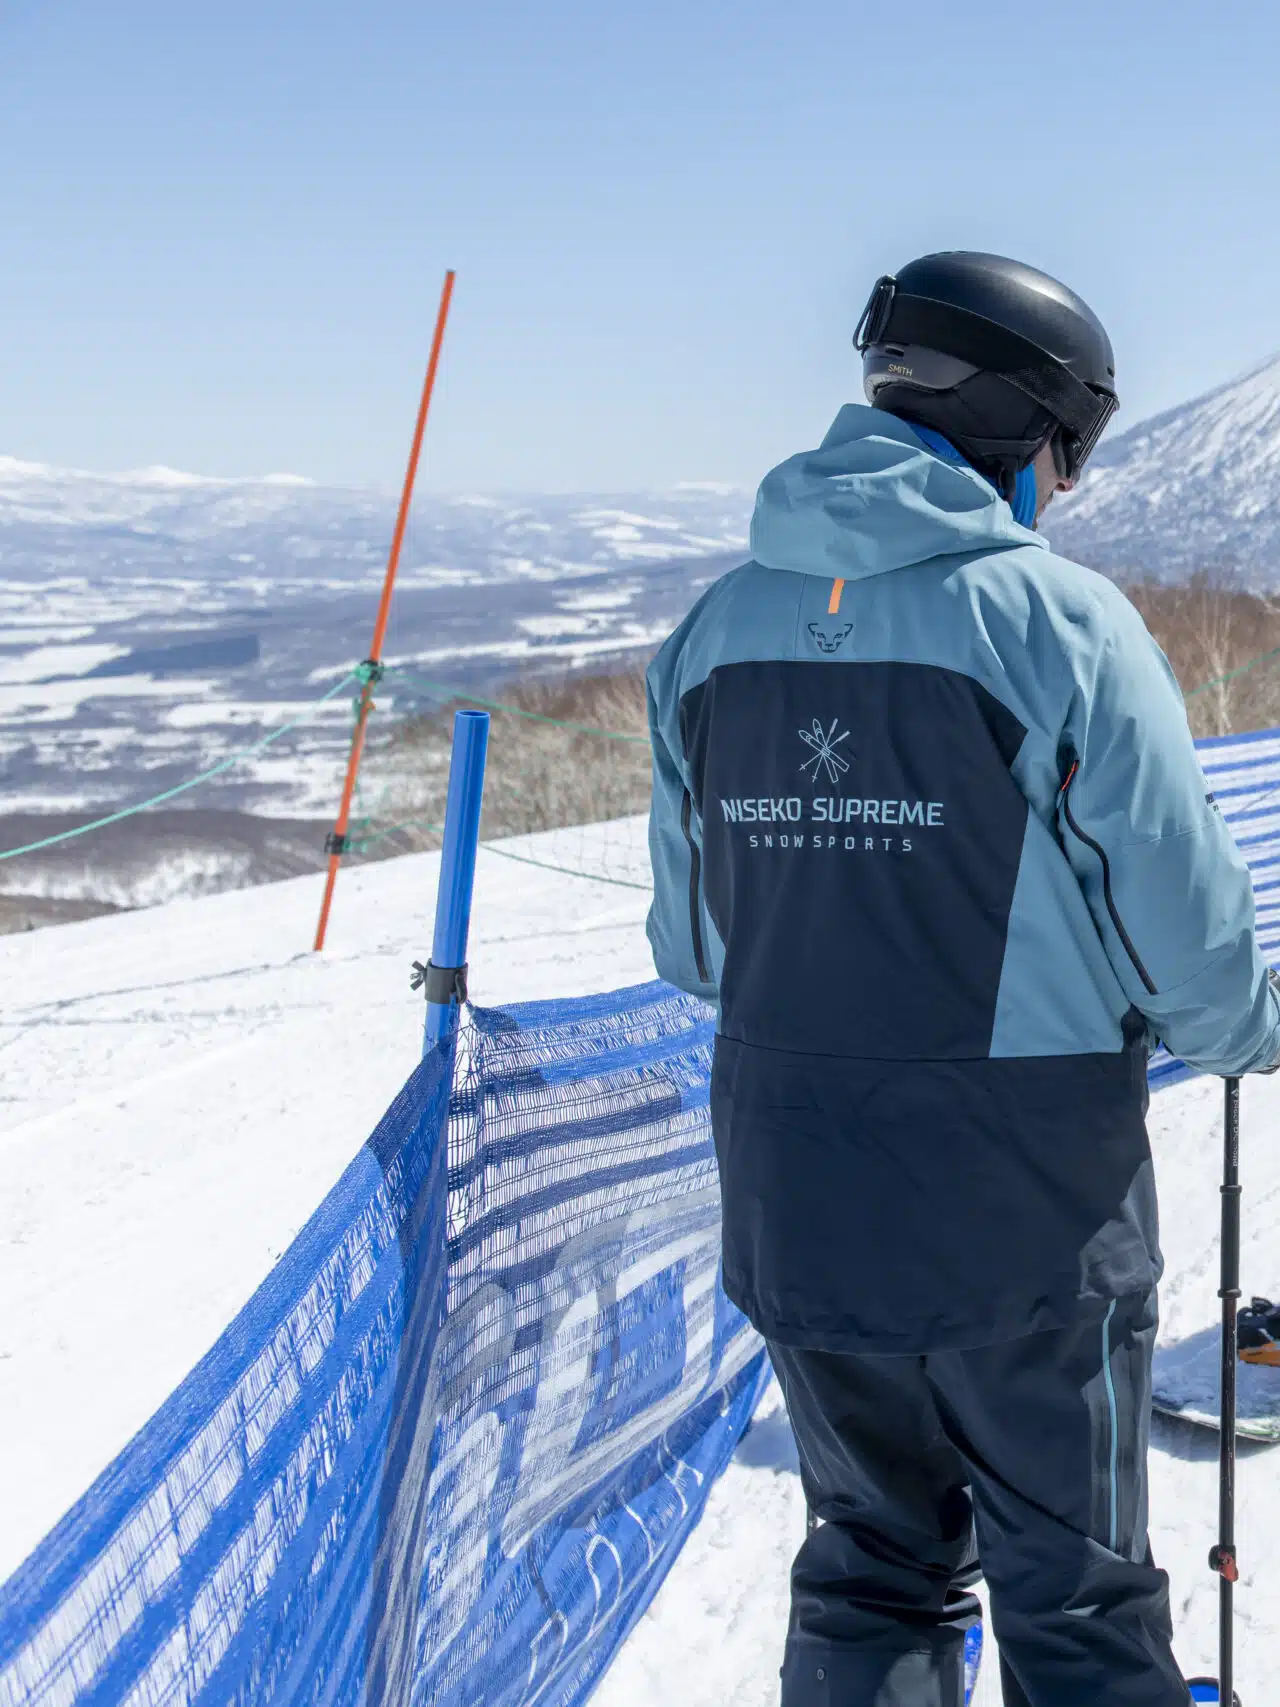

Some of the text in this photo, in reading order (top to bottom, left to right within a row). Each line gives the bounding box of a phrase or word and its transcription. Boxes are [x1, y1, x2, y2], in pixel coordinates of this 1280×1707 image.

[888, 363, 913, 377] SMITH
[720, 797, 945, 826] NISEKO SUPREME
[749, 834, 913, 852] SNOWSPORTS
